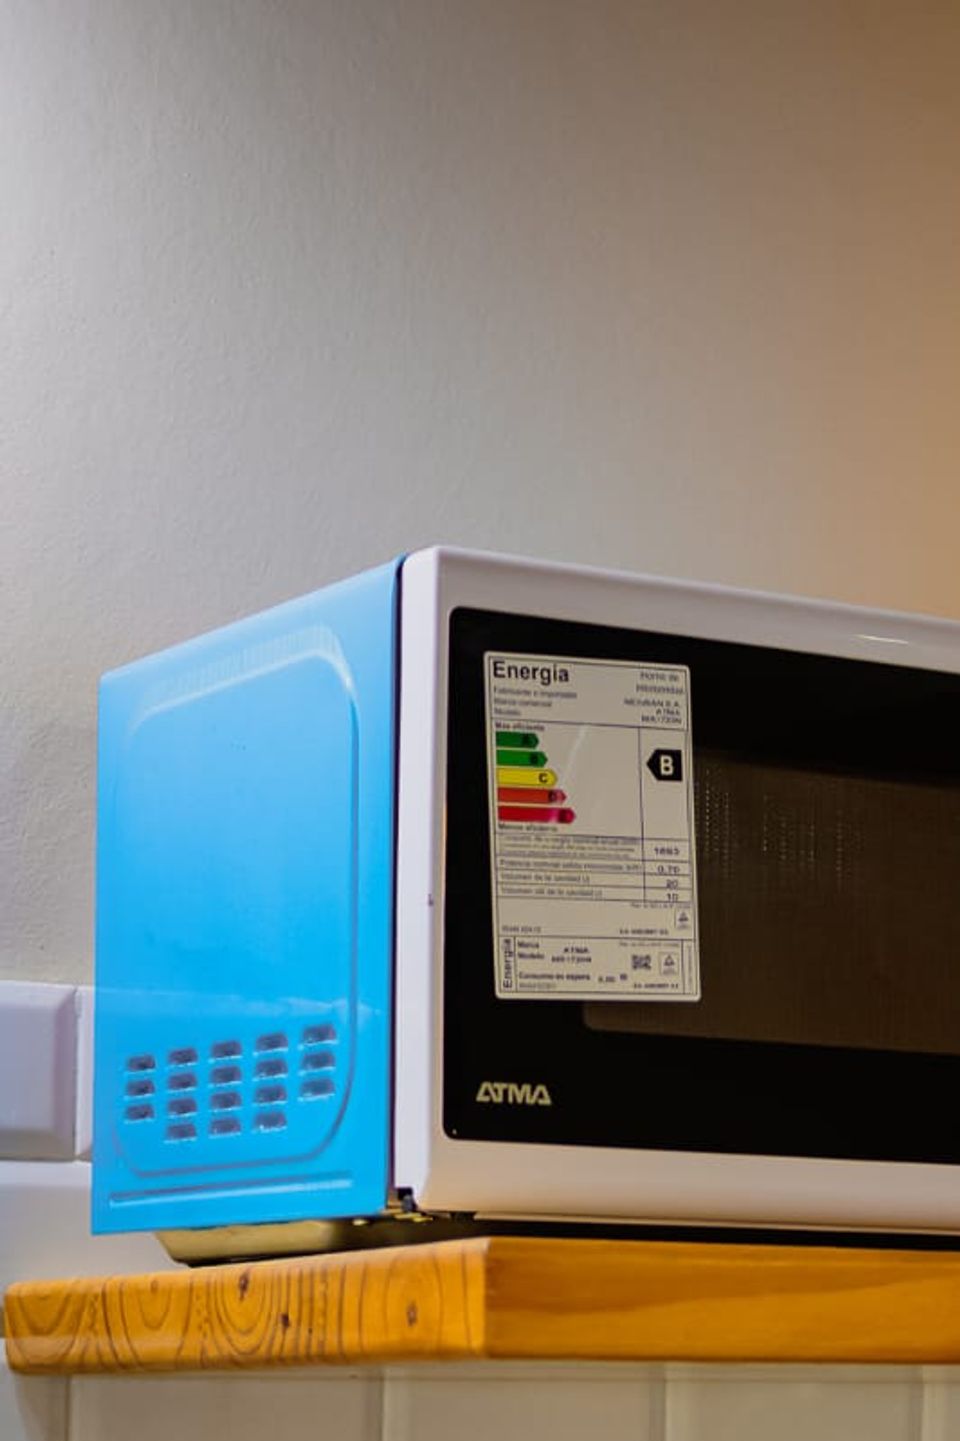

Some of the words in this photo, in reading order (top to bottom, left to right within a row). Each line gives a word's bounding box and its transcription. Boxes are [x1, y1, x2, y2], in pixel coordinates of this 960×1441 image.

[660, 754, 674, 776] B
[538, 772, 549, 783] C
[476, 1081, 552, 1106] ATMA
